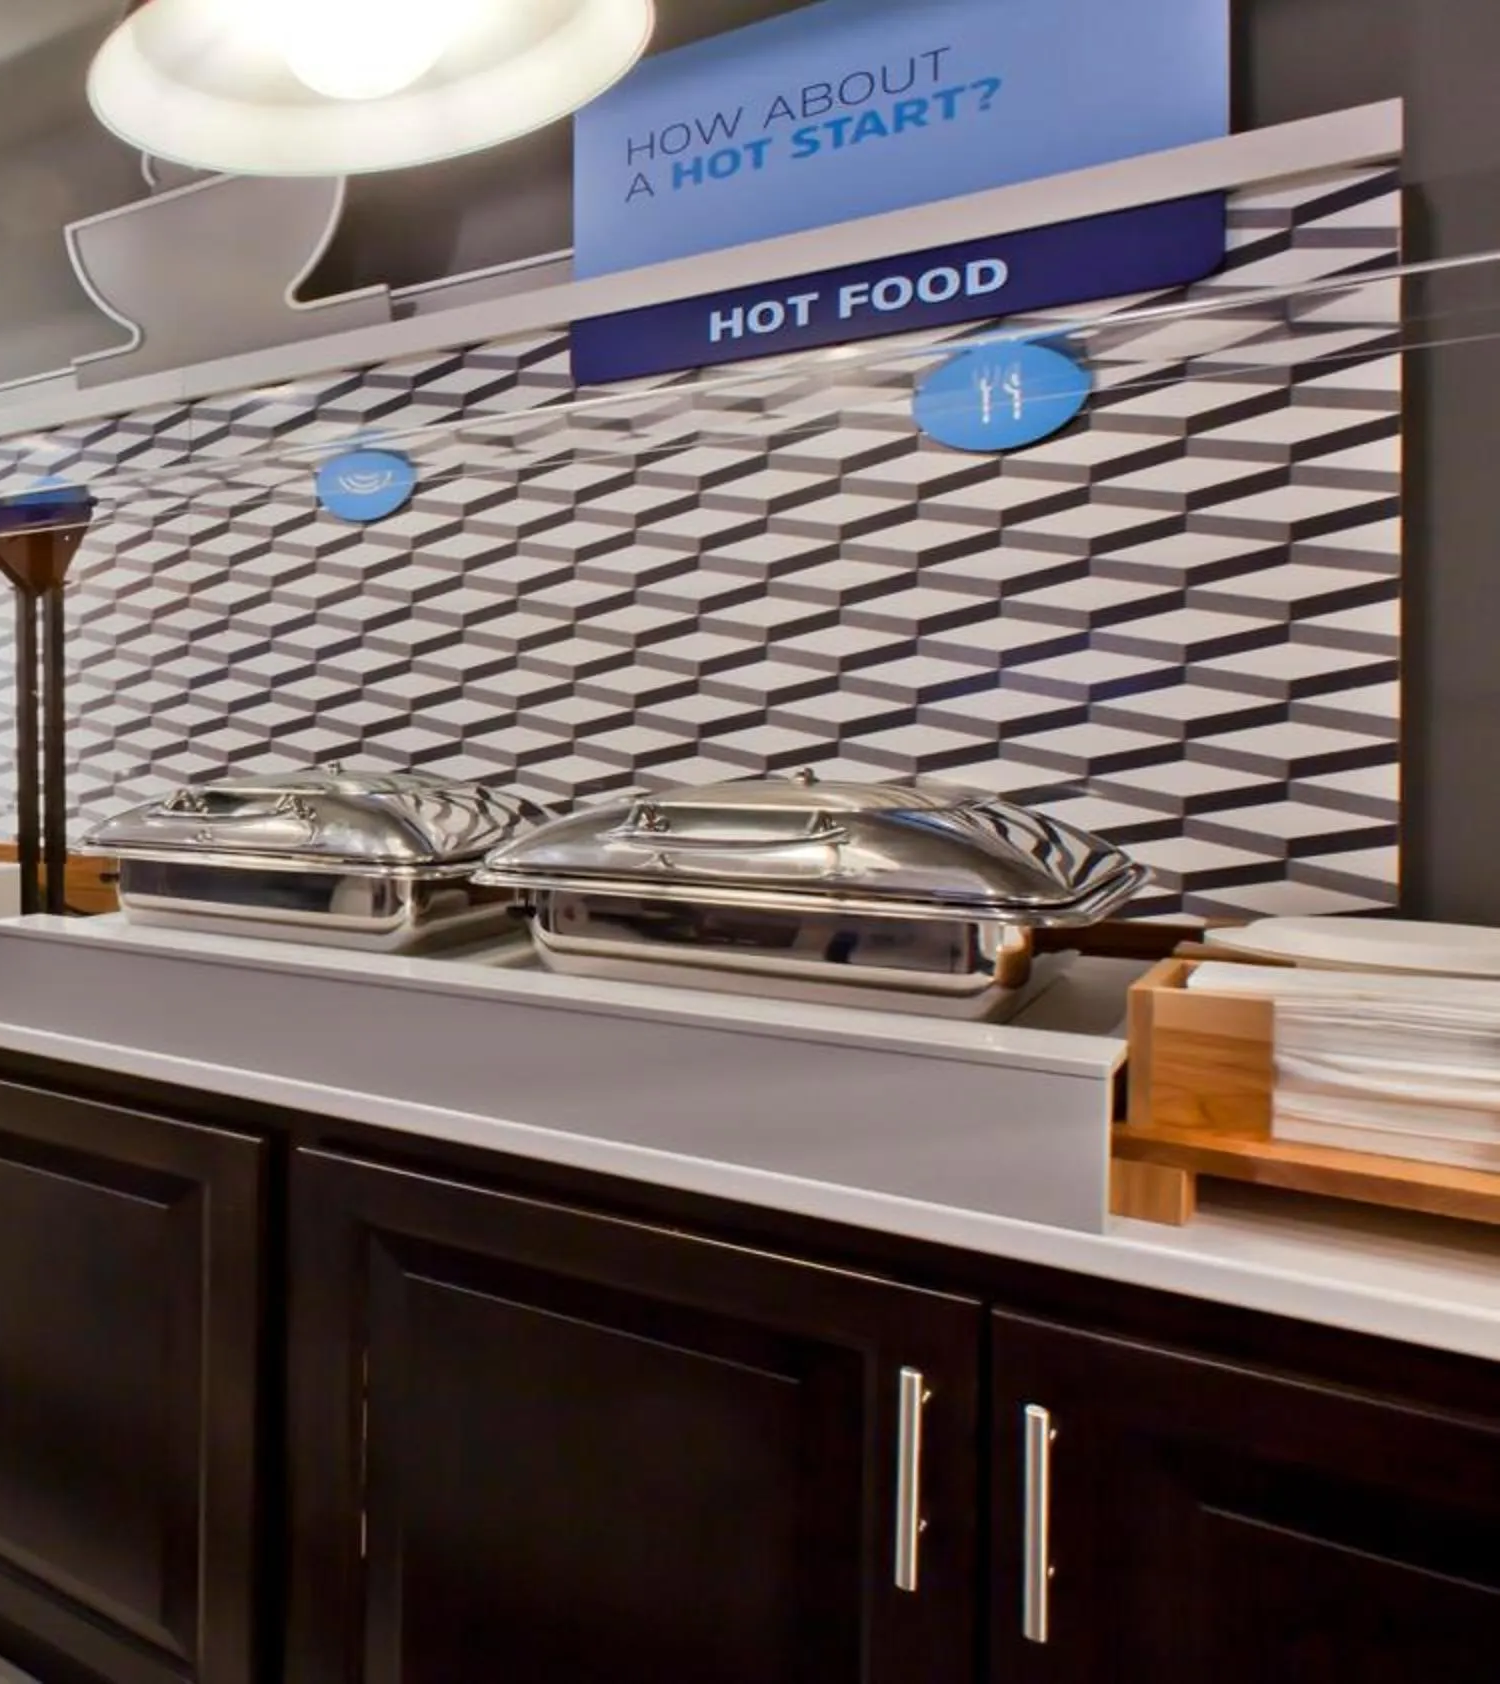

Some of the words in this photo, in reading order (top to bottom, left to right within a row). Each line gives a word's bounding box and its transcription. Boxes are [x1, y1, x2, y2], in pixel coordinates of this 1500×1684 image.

[625, 172, 655, 203] A
[671, 136, 774, 192] HOT
[790, 76, 1003, 160] START?
[626, 105, 744, 167] HOW
[763, 46, 952, 130] ABOUT
[708, 292, 820, 343] HOT
[837, 258, 1009, 320] FOOD
